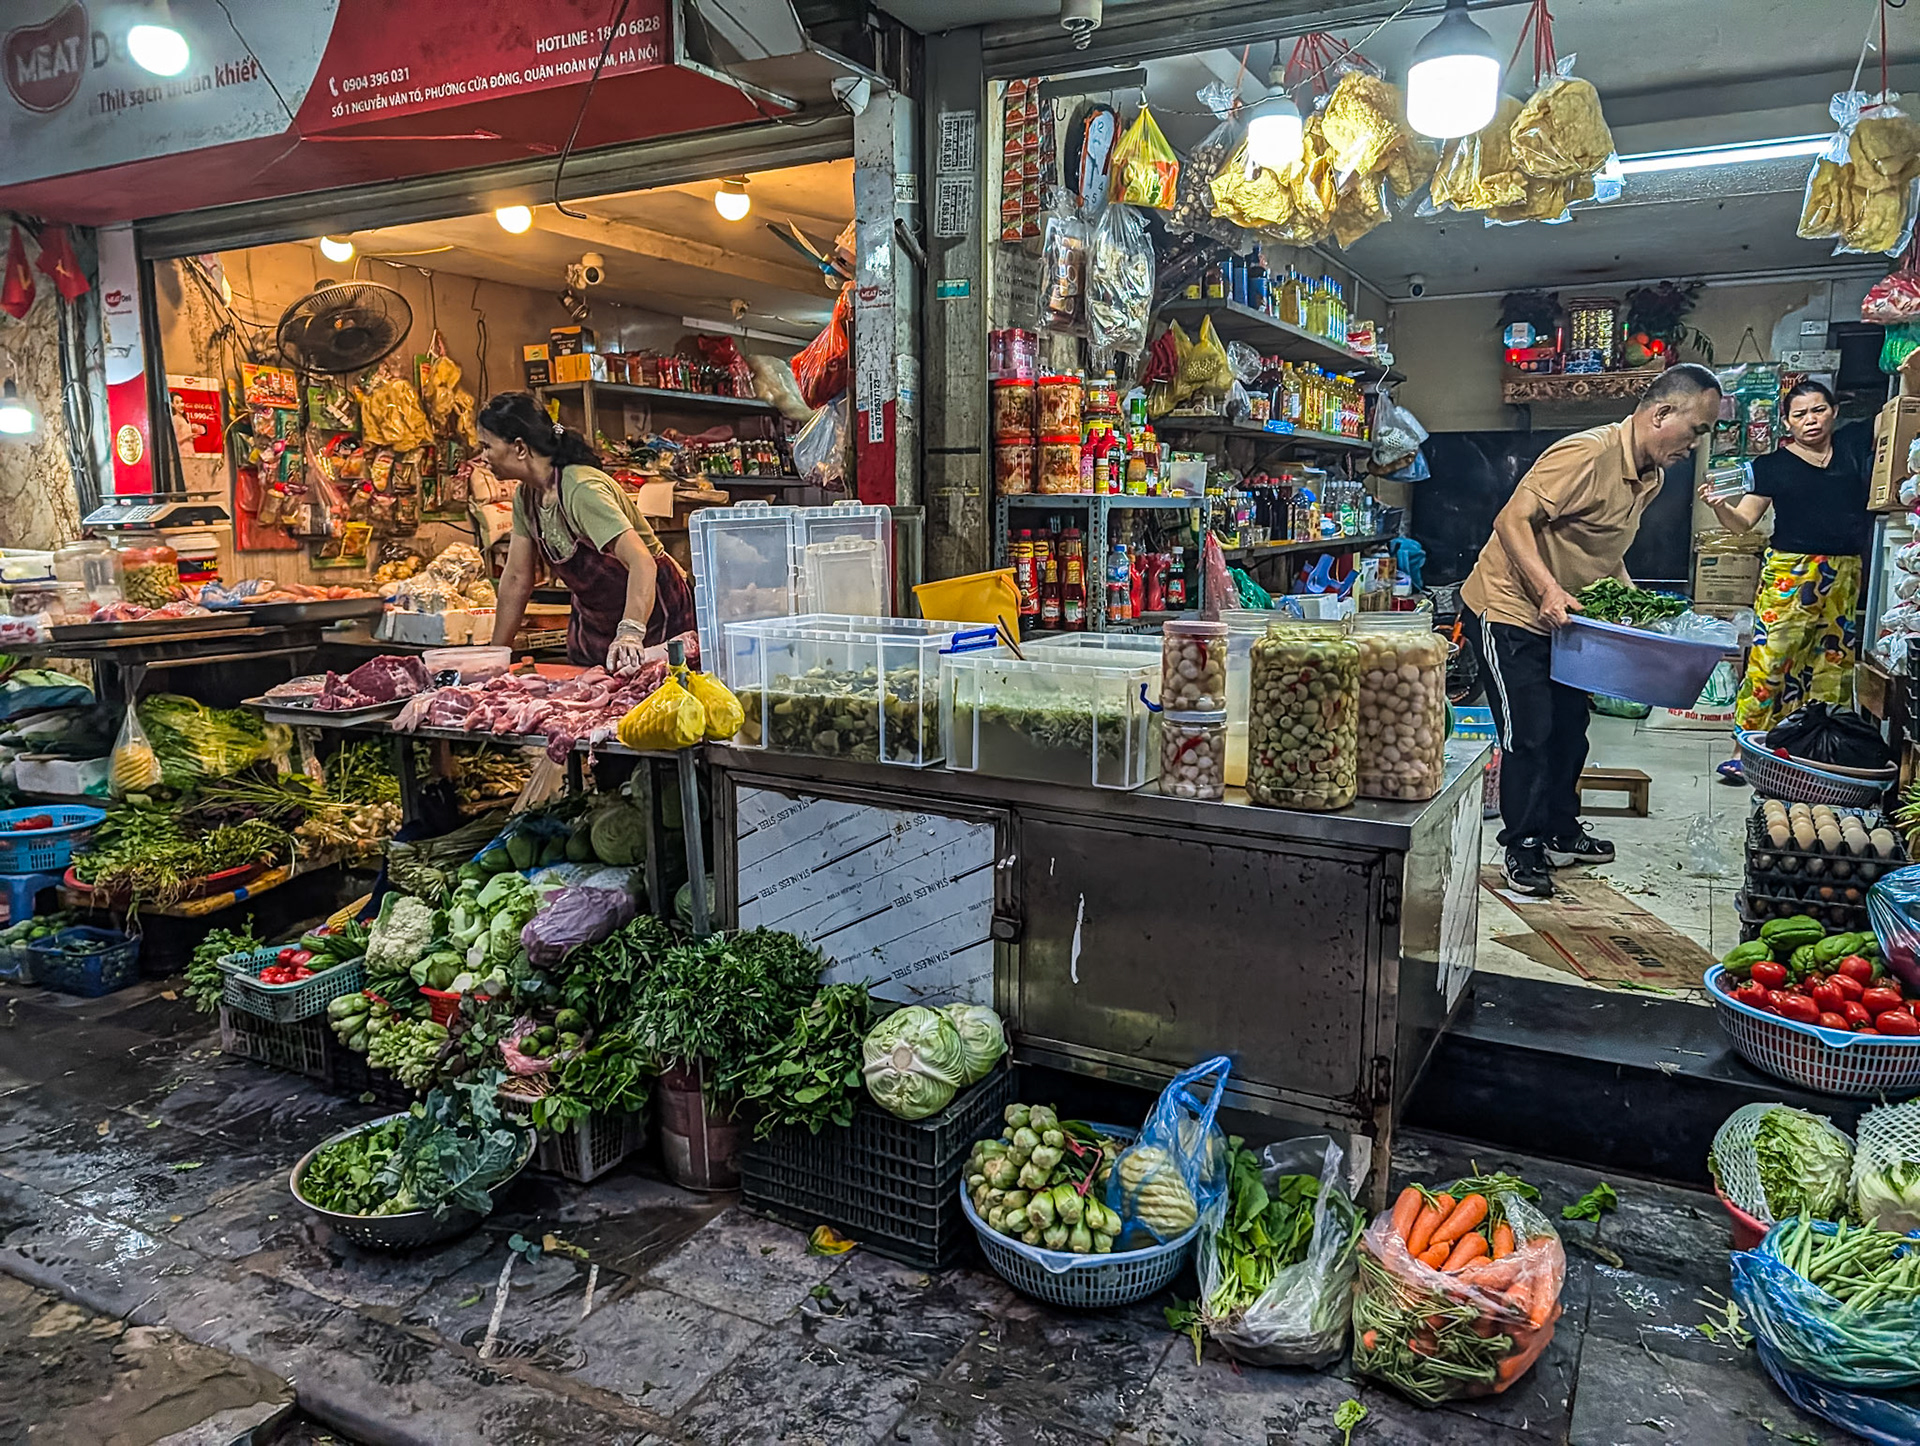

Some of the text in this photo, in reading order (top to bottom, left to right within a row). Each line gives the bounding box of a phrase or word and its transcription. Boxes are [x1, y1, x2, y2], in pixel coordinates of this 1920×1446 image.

[536, 30, 588, 54] HOTLINE
[597, 23, 627, 41] 180
[629, 15, 661, 35] 6828
[16, 36, 81, 87] MEAT
[97, 89, 127, 116] Thịt
[129, 86, 163, 111] sạch
[214, 56, 258, 88] khiết
[331, 101, 343, 118] SỐ
[345, 104, 350, 115] 1
[351, 94, 388, 114] NGUYỄN
[425, 82, 466, 100] PHƯỜNG
[467, 76, 488, 92] CỬA
[490, 70, 523, 89] ĐÔNG,
[524, 63, 554, 82] QUẬN
[555, 57, 587, 76] HOÀN
[588, 52, 618, 71] KIM,
[619, 47, 636, 64] HÀ
[638, 44, 658, 63] NỘI
[343, 67, 410, 93] 0904 396 031
[758, 816, 776, 830] STEEL
[892, 820, 912, 835] STEEL
[758, 868, 811, 898] STAINLESS STEEL
[892, 877, 950, 908] STAINLESS STEEL
[891, 950, 950, 979] STAINLESS STEEL
